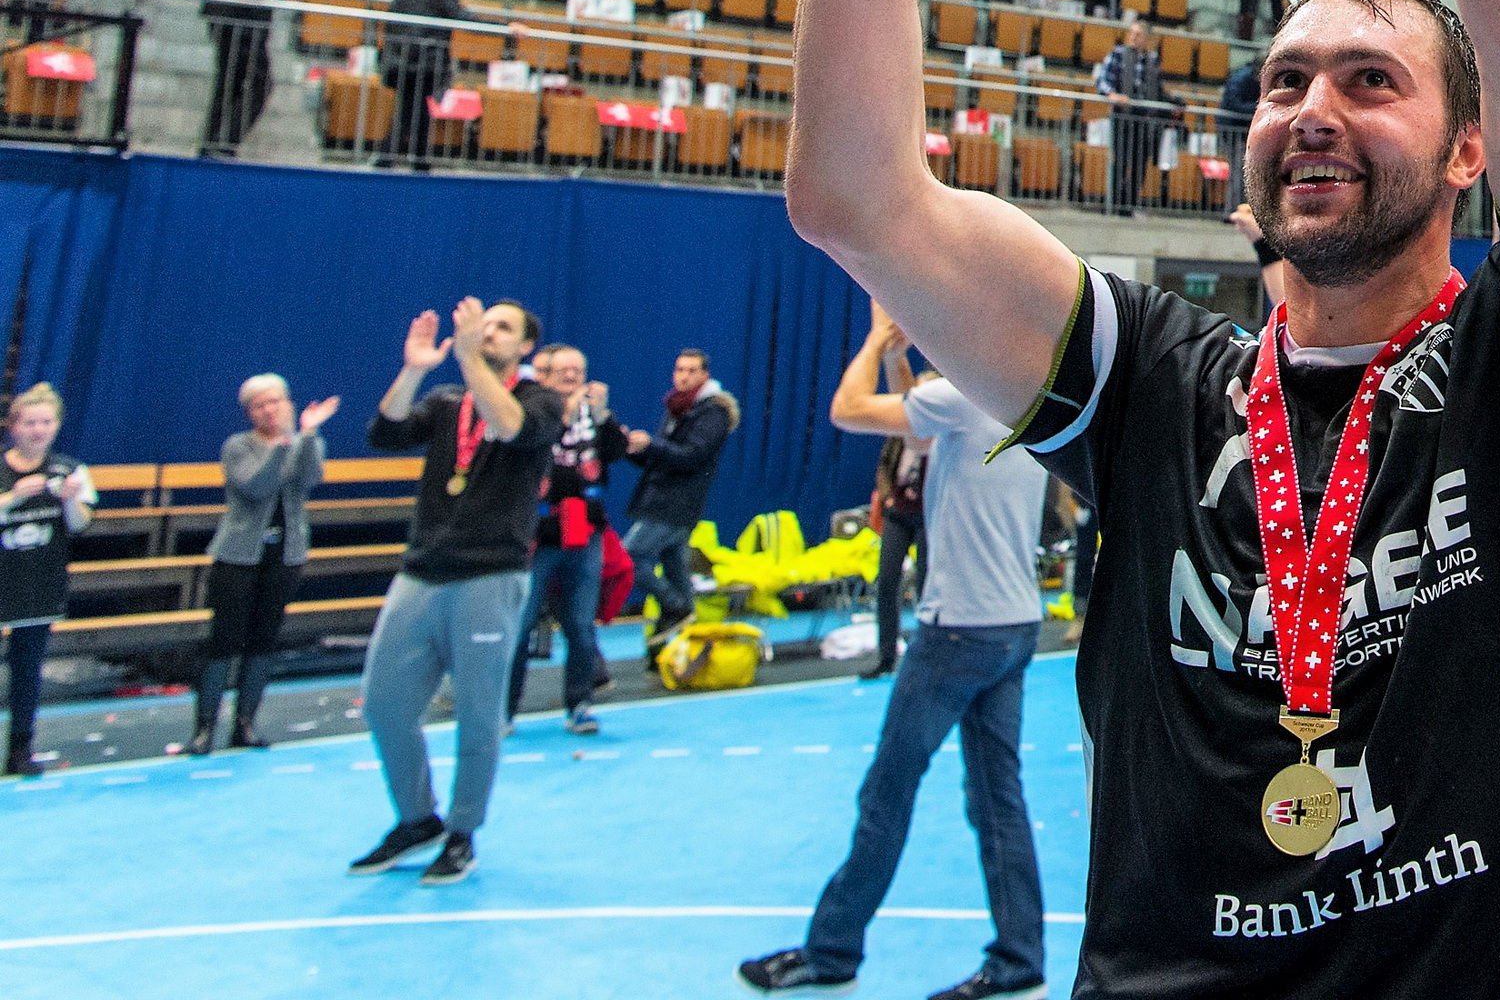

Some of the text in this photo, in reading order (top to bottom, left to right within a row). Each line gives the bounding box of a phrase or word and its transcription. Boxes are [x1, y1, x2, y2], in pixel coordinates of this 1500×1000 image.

[1436, 547, 1477, 573] UND
[1212, 832, 1489, 938] Bank Linth
